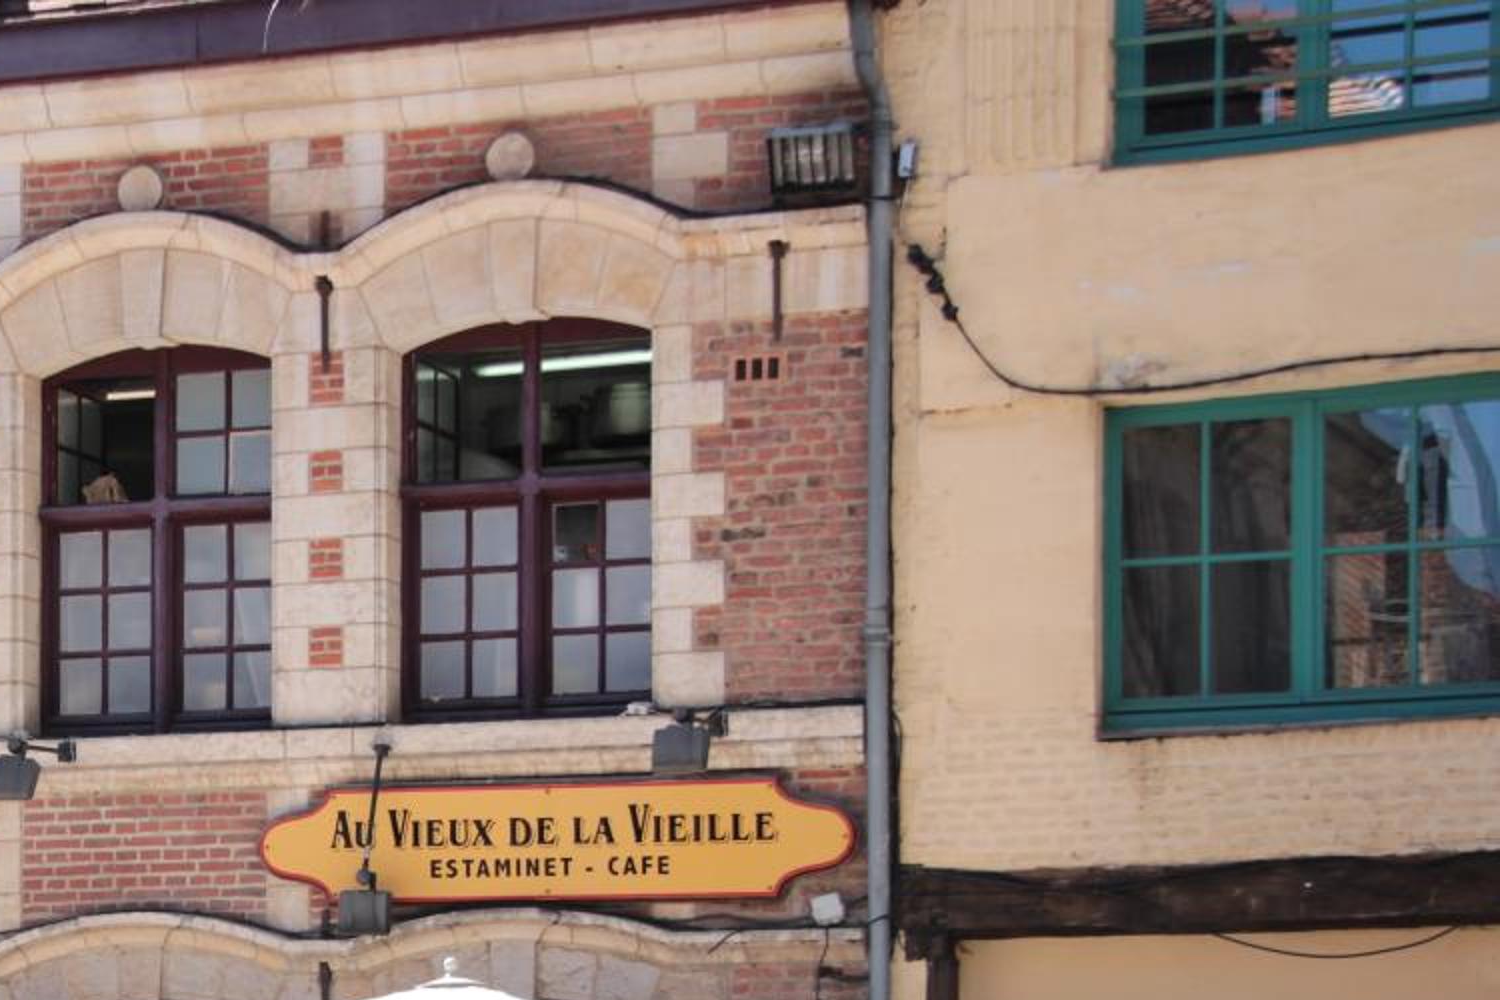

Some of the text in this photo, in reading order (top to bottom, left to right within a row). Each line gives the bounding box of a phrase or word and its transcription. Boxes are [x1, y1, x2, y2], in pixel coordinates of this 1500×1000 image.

[573, 816, 616, 845] LA
[430, 857, 573, 879] ESTAMINET
[608, 855, 671, 876] CAFE
